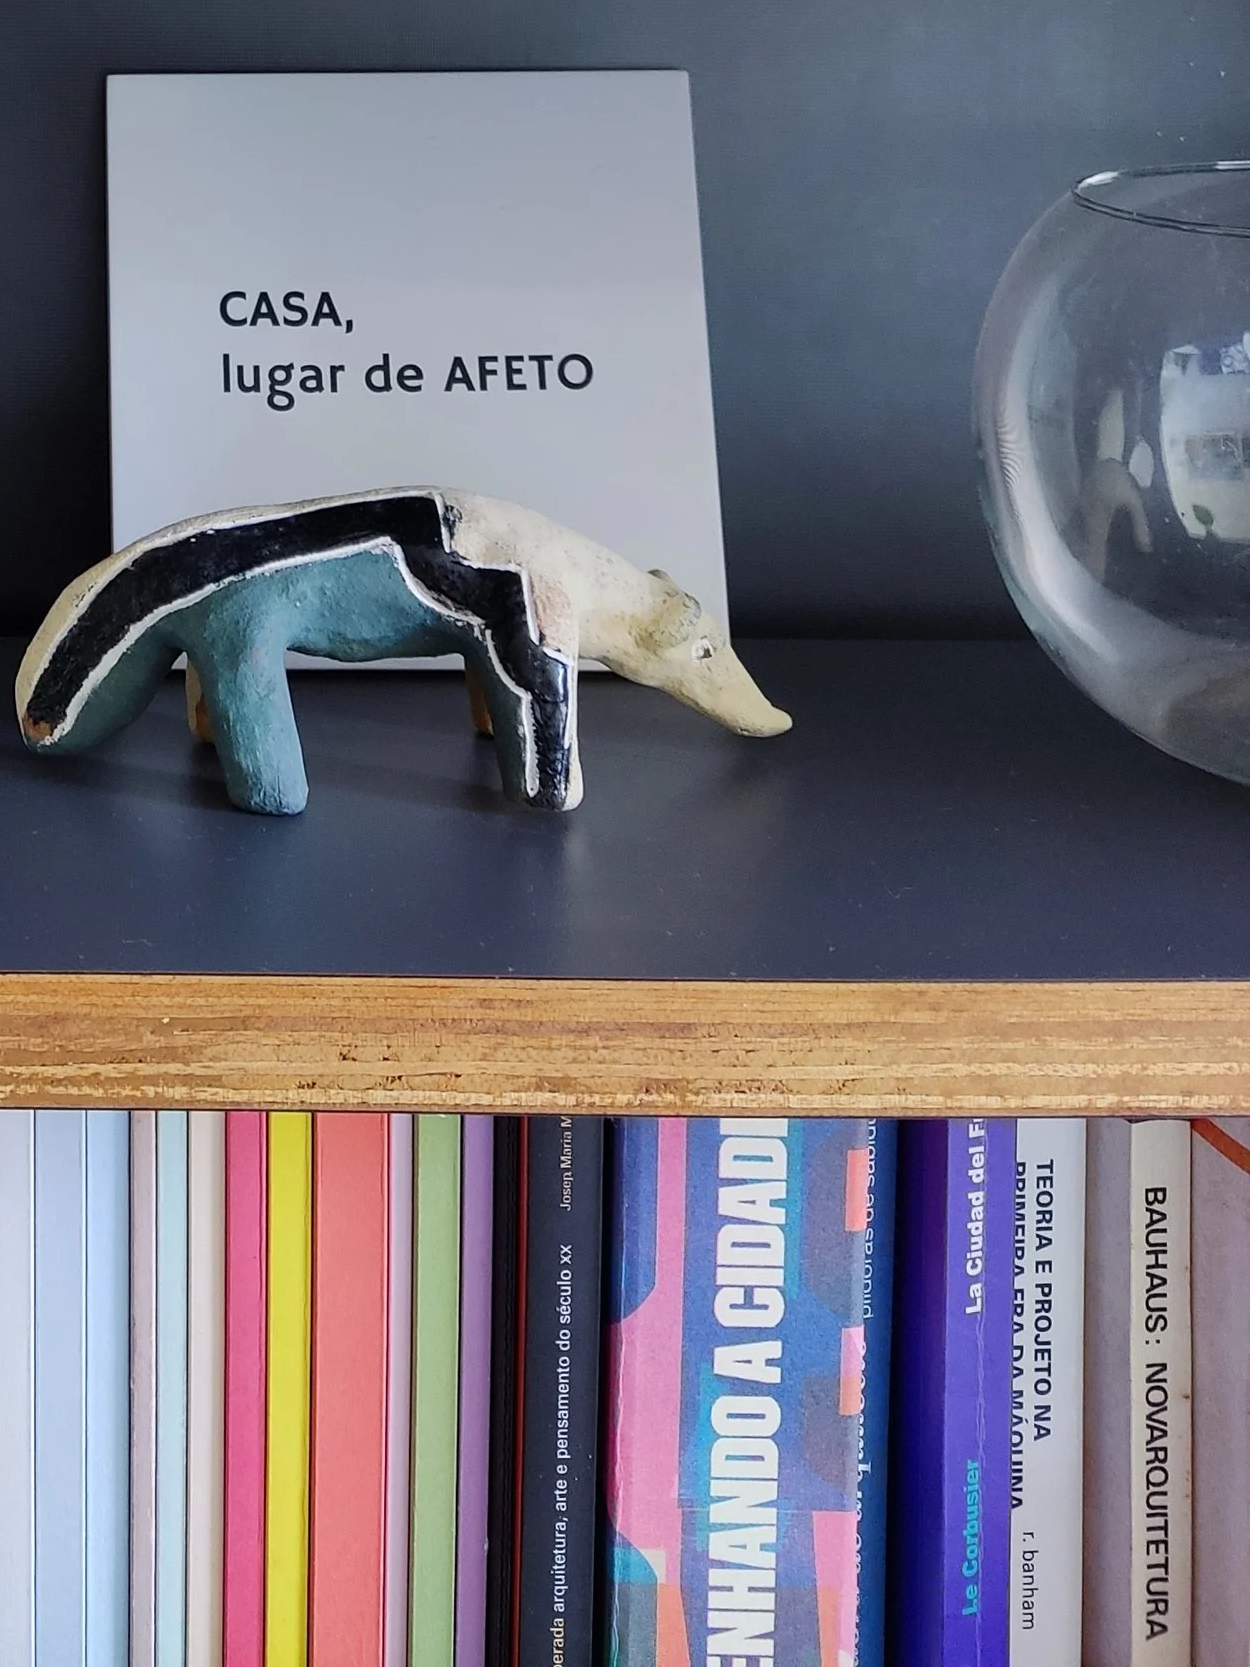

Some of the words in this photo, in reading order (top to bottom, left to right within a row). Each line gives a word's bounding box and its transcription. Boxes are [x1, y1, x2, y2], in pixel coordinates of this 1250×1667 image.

[219, 290, 354, 335] CASA,
[222, 353, 347, 412] lugar
[364, 353, 425, 393] de
[443, 353, 595, 392] AFETO
[560, 1132, 572, 1169] Maria
[968, 1119, 986, 1139] F
[967, 1145, 985, 1184] del
[1036, 1159, 1054, 1252] TEORIA
[966, 1191, 984, 1276] Ciudad
[1036, 1258, 1053, 1274] E
[556, 1267, 573, 1324] século
[964, 1282, 983, 1315] La
[556, 1328, 573, 1350] do
[1034, 1282, 1053, 1394] PROJETO
[712, 1340, 784, 1385] A
[556, 1354, 573, 1460] pensamento
[1034, 1404, 1052, 1441] NA
[557, 1465, 568, 1477] e
[556, 1481, 568, 1510] arte
[1144, 1362, 1170, 1641] NOVARQUITETURA
[962, 1458, 981, 1584] Corbusier
[1023, 1530, 1035, 1544] r.
[551, 1516, 569, 1613] arquitetura,
[962, 1590, 980, 1617] Le
[1021, 1548, 1037, 1630] banham
